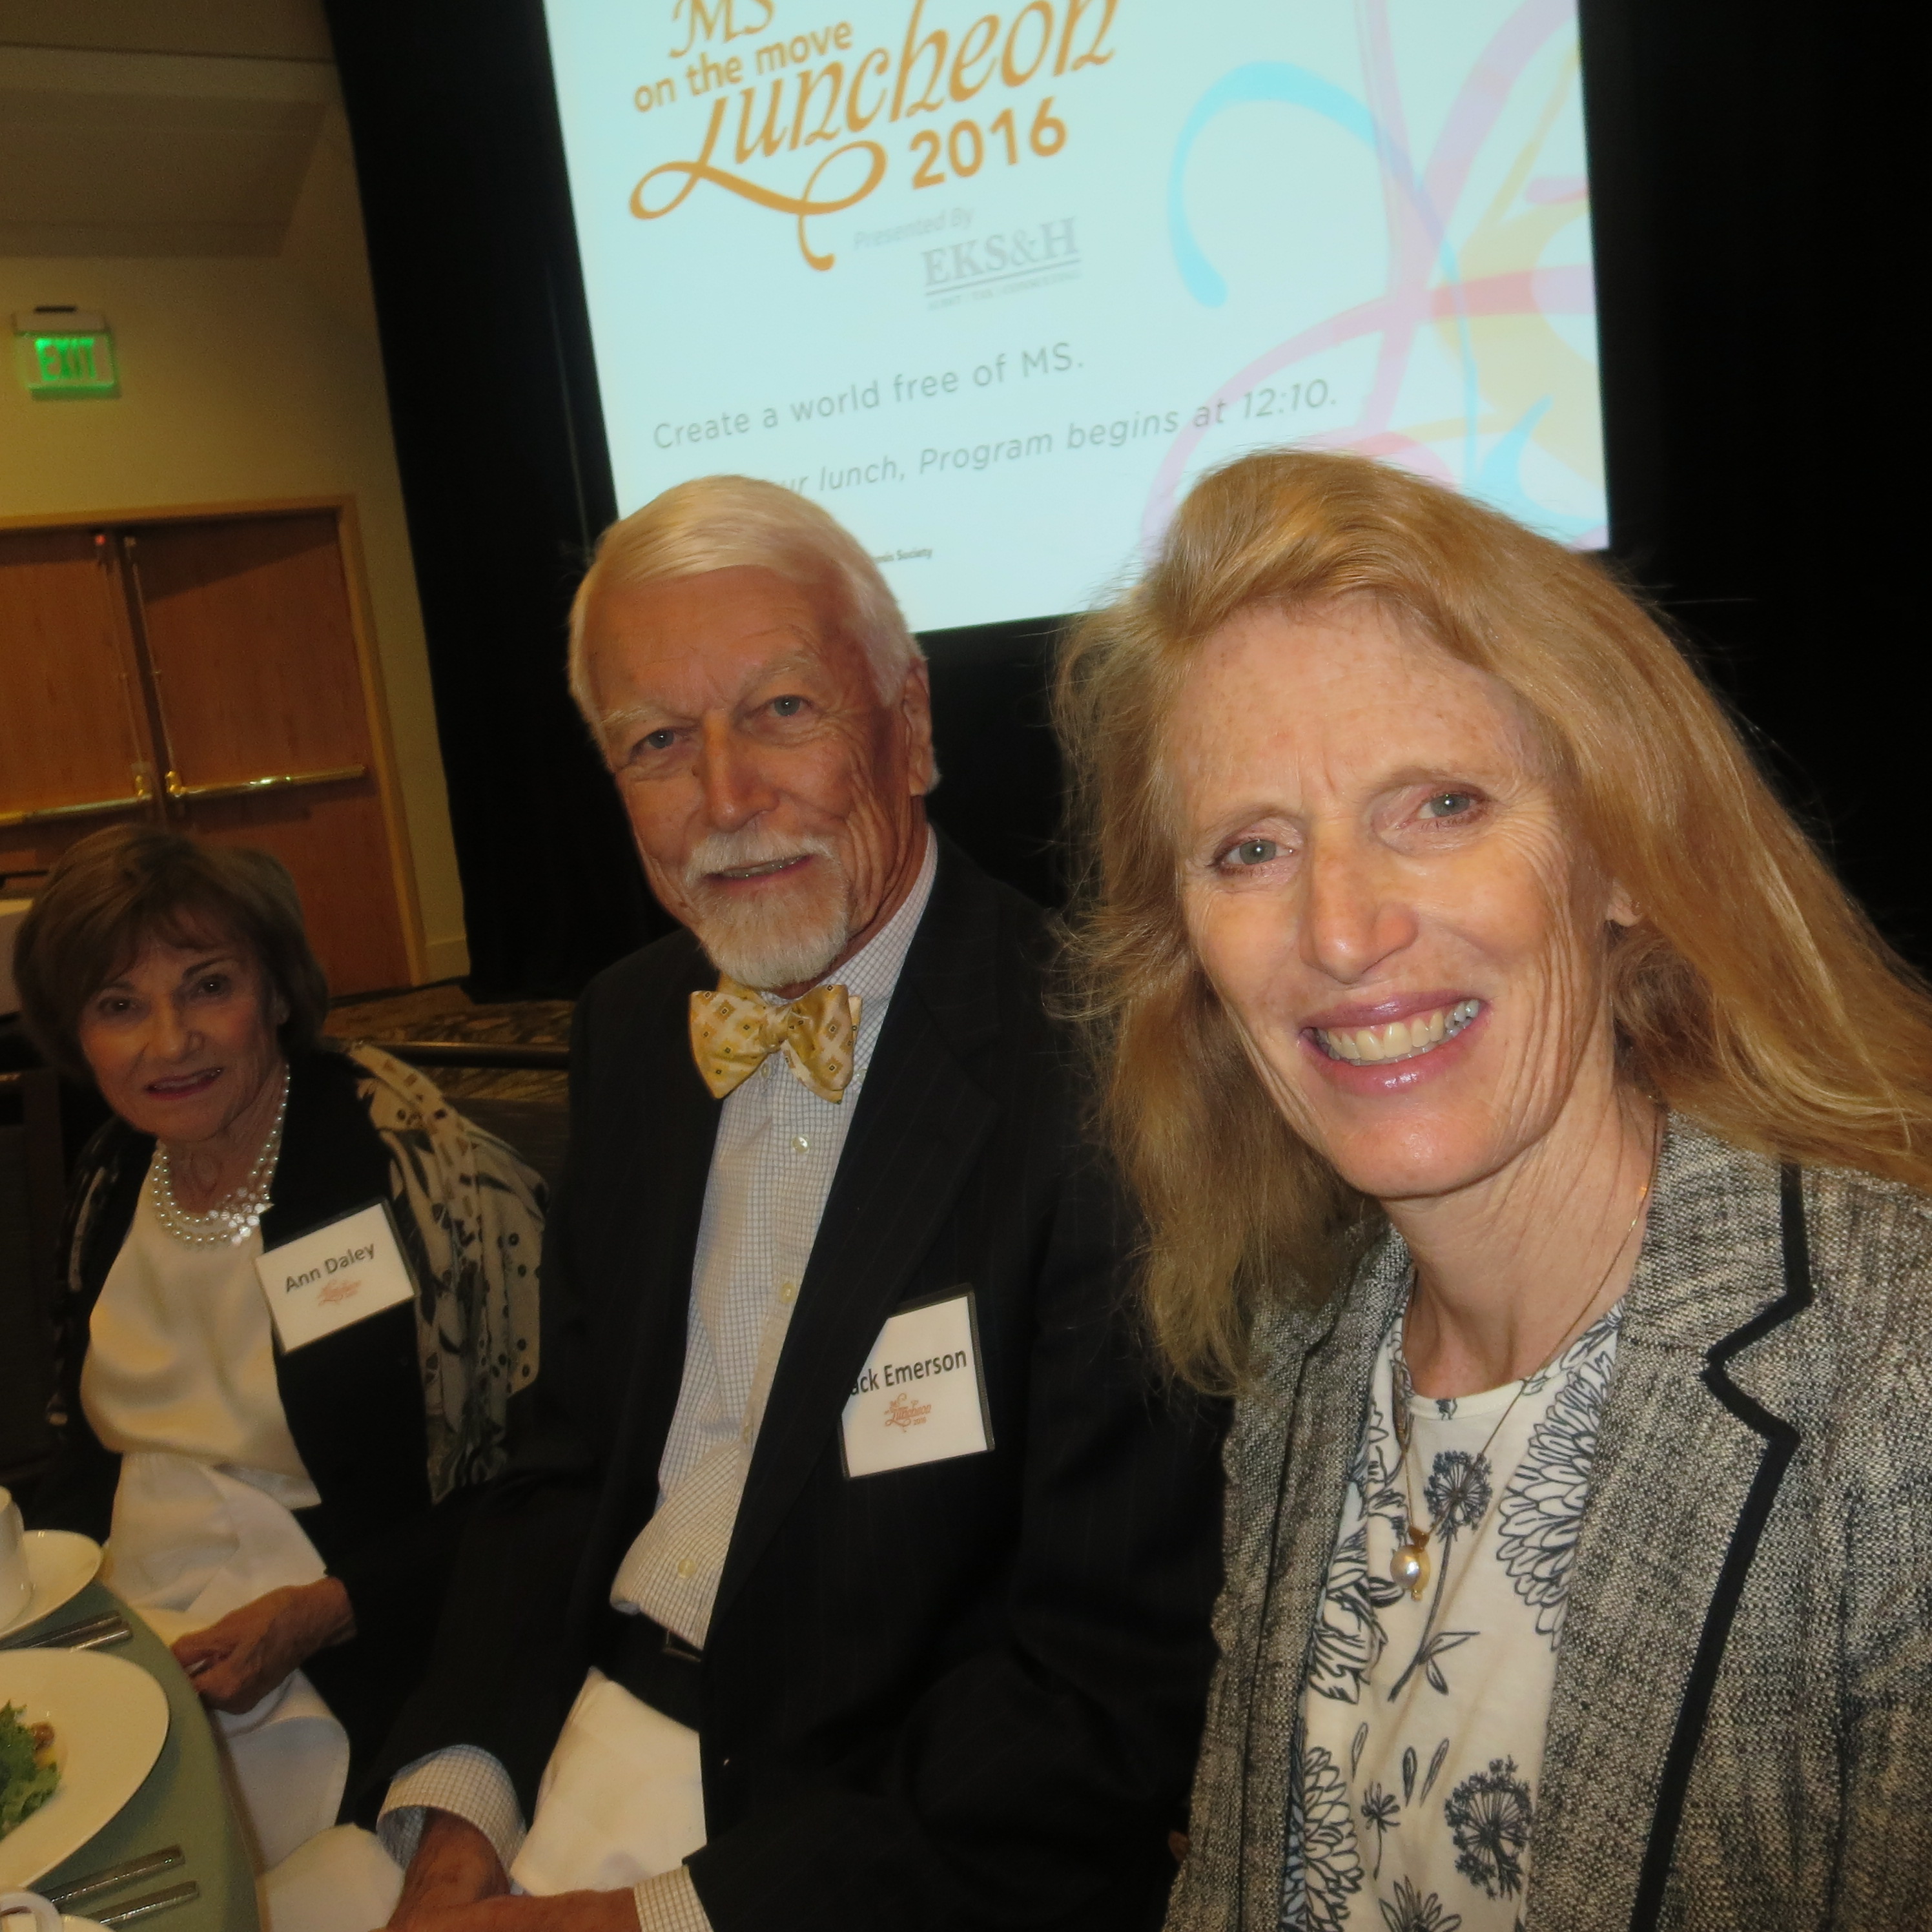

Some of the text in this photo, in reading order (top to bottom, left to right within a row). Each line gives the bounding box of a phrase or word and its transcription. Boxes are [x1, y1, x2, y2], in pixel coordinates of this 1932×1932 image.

[633, 21, 853, 113] on the move
[630, 0, 1116, 271] Luncheon
[909, 96, 1068, 190] 2016
[921, 216, 1082, 285] EKS&H
[34, 337, 96, 381] EXIT
[653, 342, 1084, 449] Create a world free of MS.
[780, 378, 1337, 495] ur lunch, Program begins at 12:10.
[285, 1268, 321, 1294] Ann
[324, 1243, 375, 1275] Daley
[850, 1349, 967, 1396] ack Emerson
